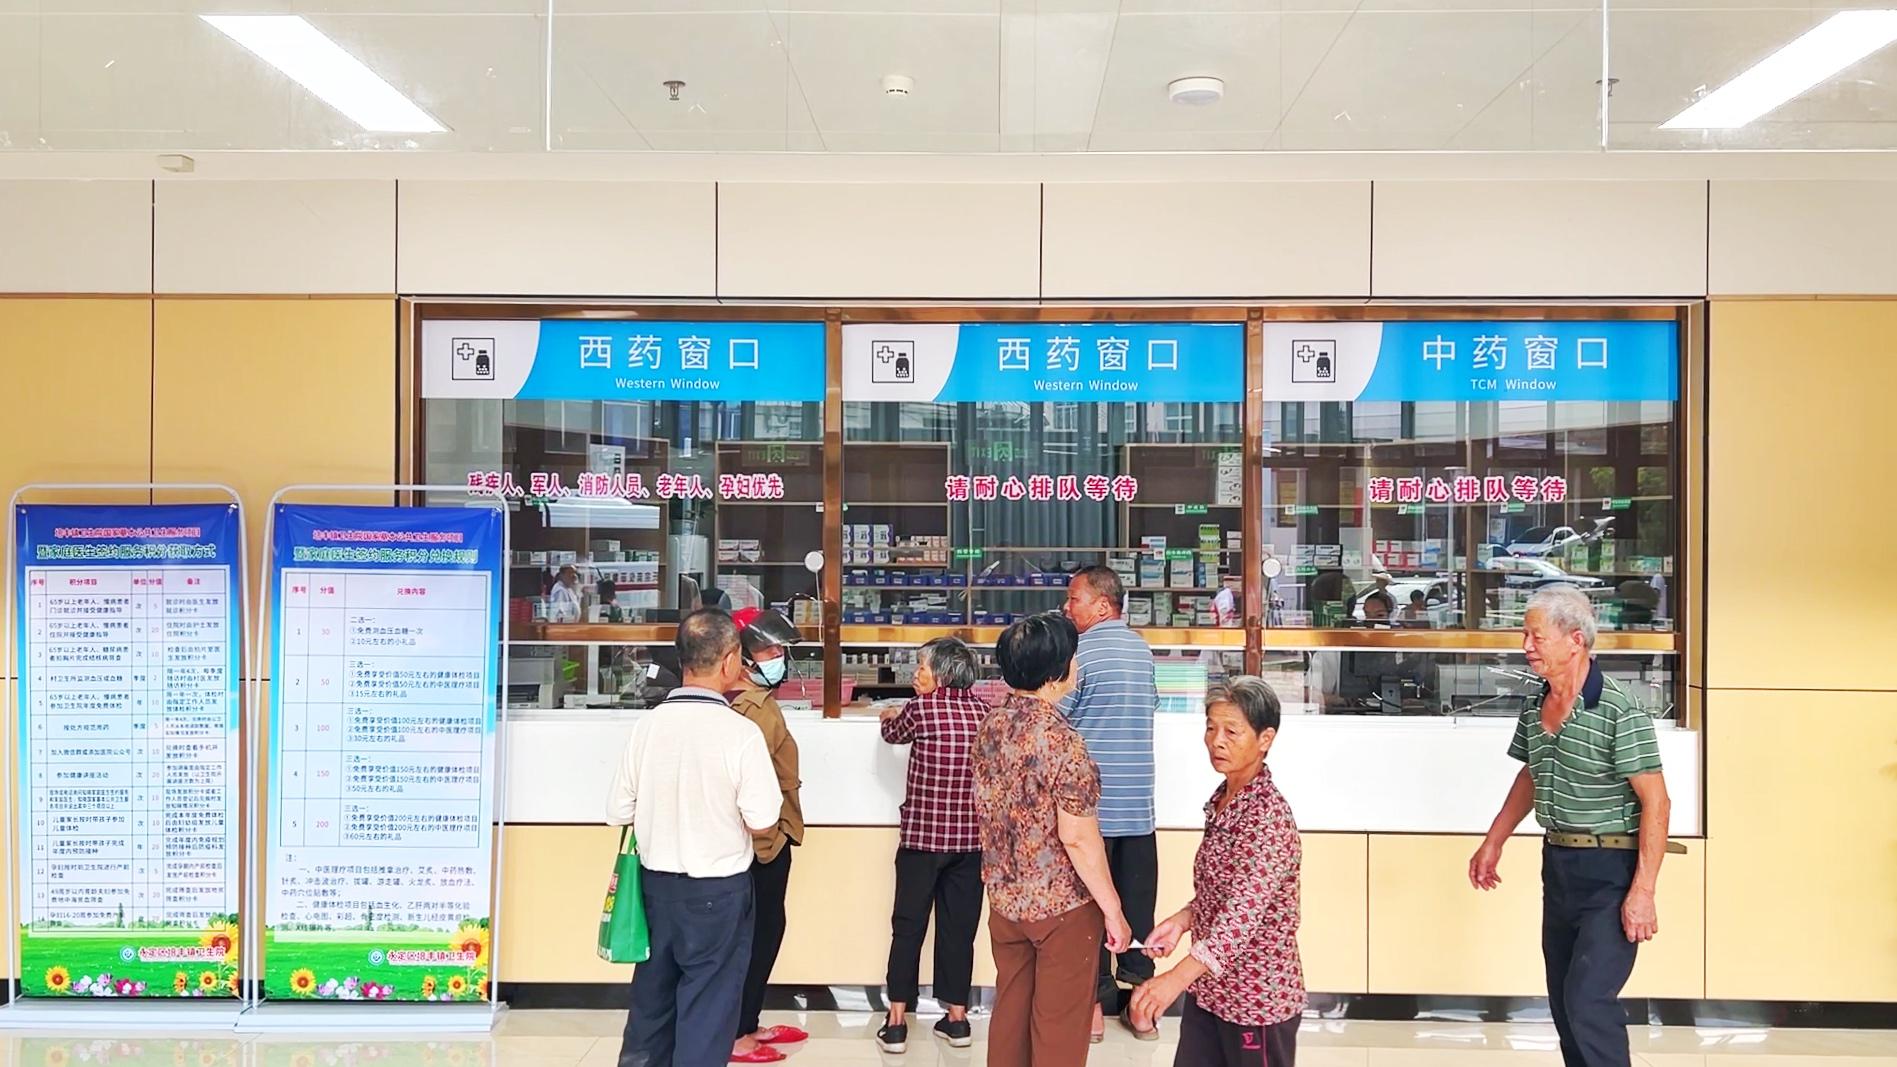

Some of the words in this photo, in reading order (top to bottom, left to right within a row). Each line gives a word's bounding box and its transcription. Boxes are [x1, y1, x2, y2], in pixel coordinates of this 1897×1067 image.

[579, 334, 760, 371] 西药窗口
[997, 334, 1178, 372] 西药窗口
[1423, 334, 1608, 371] 中药窗口
[615, 377, 666, 391] Western
[669, 377, 720, 391] Window
[1033, 378, 1084, 392] Western
[1088, 378, 1138, 392] Window
[1470, 378, 1498, 391] TCM
[1504, 378, 1556, 391] Window
[467, 473, 784, 498] 残疾人、军人、消防人员、老年人、孕妇优先
[945, 475, 1139, 503] 请耐心排队等待
[1368, 475, 1568, 504] 请耐心排队等待
[69, 578, 97, 586] 积分项目
[133, 578, 146, 586] 单位
[149, 578, 162, 586] 分值
[292, 586, 306, 594] 序号
[320, 586, 334, 594] 分值
[397, 588, 426, 596] 兑换内容
[321, 678, 330, 686] 50
[317, 724, 330, 732] 100
